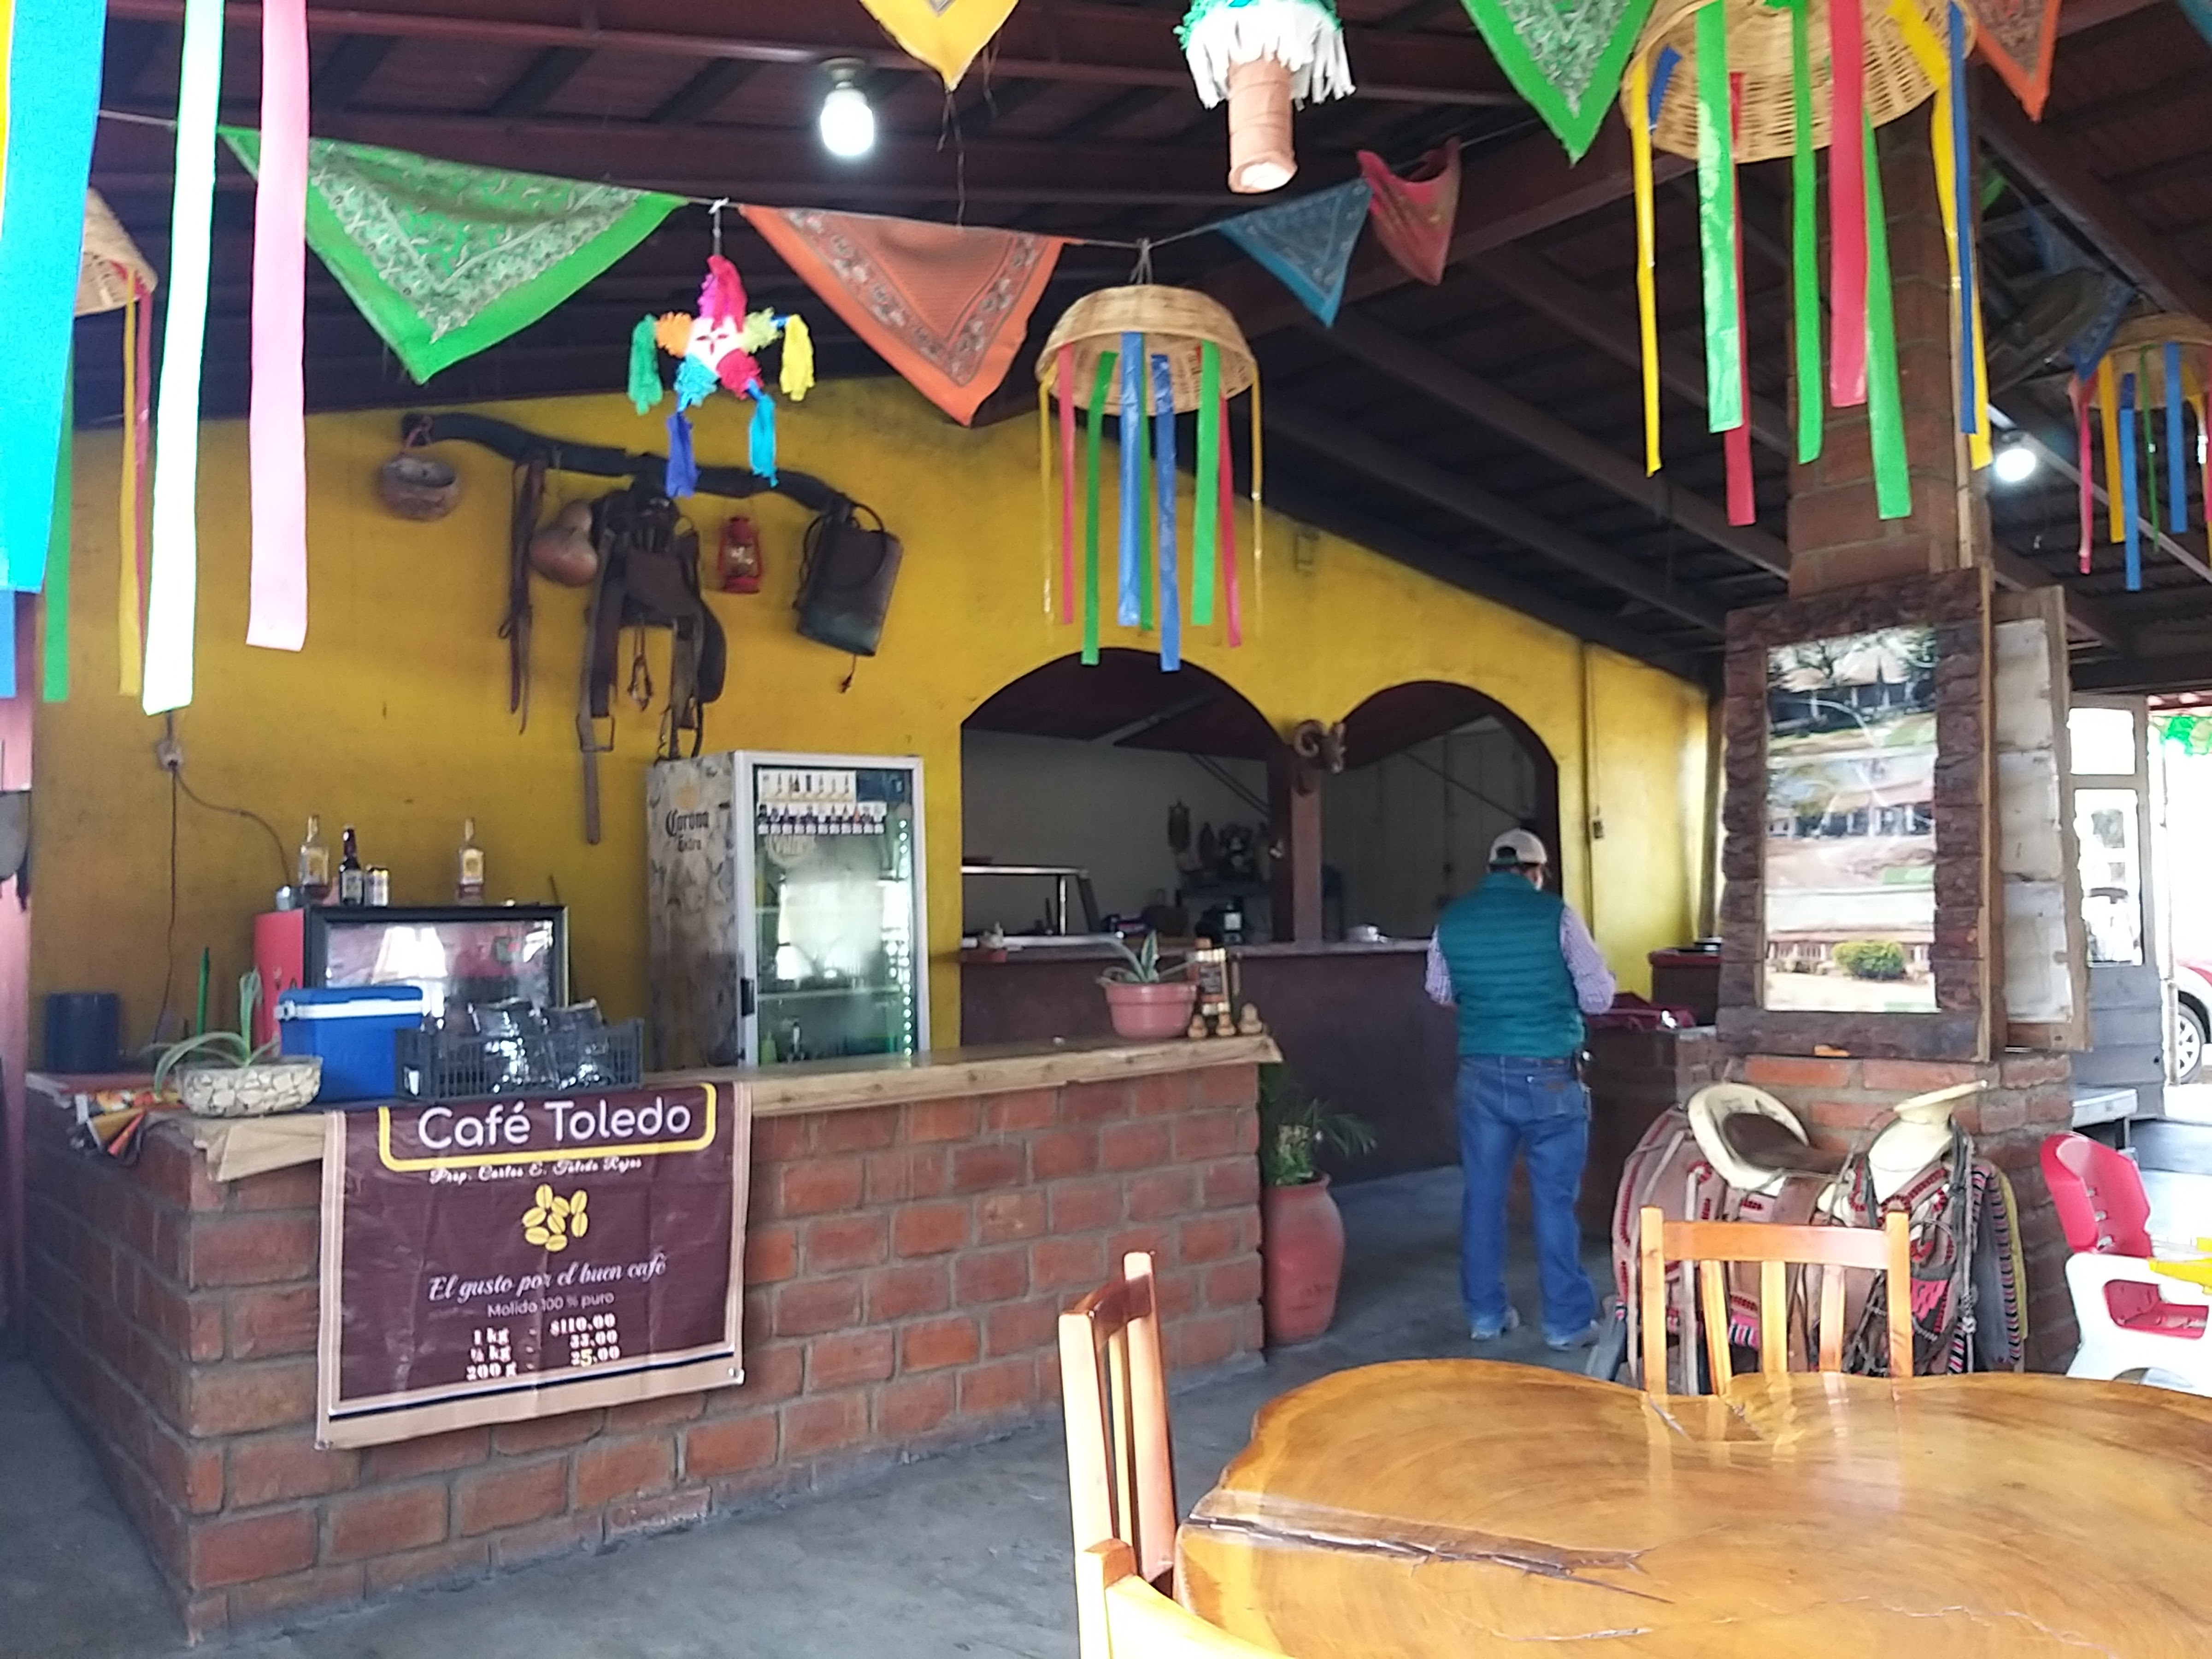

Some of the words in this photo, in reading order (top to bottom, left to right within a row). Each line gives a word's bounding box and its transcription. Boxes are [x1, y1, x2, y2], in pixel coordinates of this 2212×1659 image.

[665, 809, 709, 837] Corona
[418, 1100, 531, 1149] Café
[544, 1096, 691, 1141] Toledo
[553, 1159, 599, 1176] Toledo
[428, 1274, 458, 1301] El
[457, 1274, 513, 1304] gusto
[516, 1273, 552, 1297] por
[557, 1262, 578, 1287] el
[579, 1262, 624, 1284] buen
[627, 1252, 667, 1282] café
[488, 1300, 538, 1318] Molido
[540, 1297, 563, 1312] 100
[581, 1291, 615, 1309] puro
[474, 1329, 482, 1346] 1
[487, 1327, 510, 1346] kg
[549, 1312, 616, 1337] $110.00
[466, 1362, 502, 1381] 200
[505, 1360, 517, 1378] g
[570, 1345, 620, 1367] 25.00
[489, 1345, 512, 1363] kg
